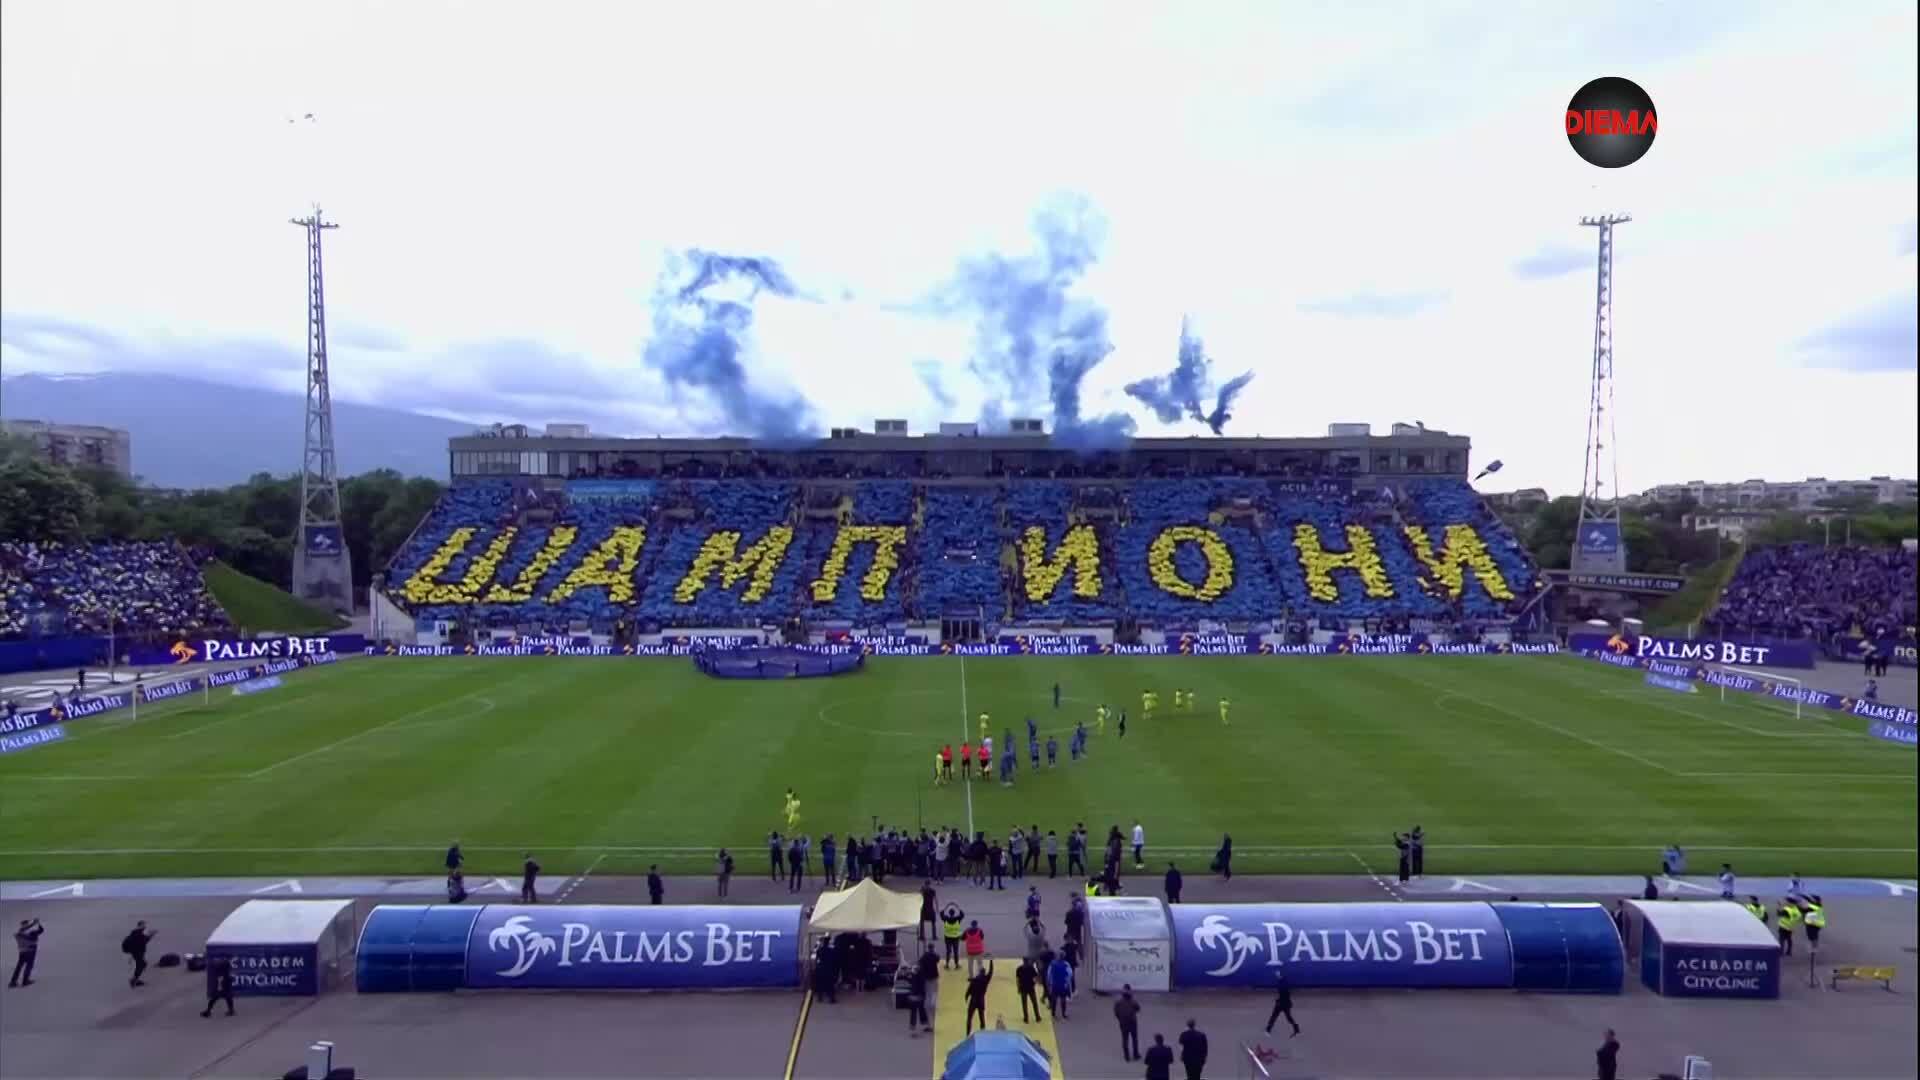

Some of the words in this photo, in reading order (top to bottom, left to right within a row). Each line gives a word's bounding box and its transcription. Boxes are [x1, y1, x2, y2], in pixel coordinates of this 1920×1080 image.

[522, 635, 554, 646] PALMS
[556, 636, 573, 646] BET
[854, 635, 886, 646] PALMS
[1028, 635, 1061, 645] PALMS
[1064, 635, 1081, 644] ET
[1227, 634, 1245, 644] BET
[1360, 634, 1392, 644] PAMS
[1394, 634, 1412, 644] BET
[204, 639, 282, 661] PALMS
[287, 636, 330, 656] BET
[399, 645, 433, 656] PALMS
[434, 645, 454, 656] BET
[478, 644, 511, 656] PALMS
[514, 644, 533, 656] BET
[557, 644, 590, 656] PALMS
[593, 644, 612, 656] BET
[672, 644, 691, 656] BET
[831, 644, 850, 655] BET
[875, 644, 909, 655] PALMS
[911, 644, 929, 655] BET
[955, 644, 988, 655] PALMS
[990, 644, 1010, 655] BET
[1034, 643, 1068, 654] PALMS
[1070, 643, 1089, 654] BET
[1114, 643, 1148, 654] PALMS
[1150, 643, 1169, 654] BET
[1193, 643, 1227, 654] PALMS
[1229, 643, 1248, 654] BET
[1273, 643, 1307, 654] PALMS
[1309, 643, 1328, 654] BET
[1352, 643, 1386, 654] PALMS
[1388, 643, 1407, 654] BET
[1432, 643, 1466, 654] PALMS
[1468, 643, 1486, 654] BET
[1512, 642, 1546, 654] PALMS
[1636, 635, 1715, 661] PALMS
[1721, 641, 1769, 664] BET
[1649, 660, 1674, 675] PALMS
[208, 671, 236, 687] PALMS
[1706, 670, 1735, 686] PALMS
[1735, 677, 1754, 689] BET
[144, 683, 175, 701] PALMS
[176, 681, 192, 694] BET
[1774, 682, 1806, 700] PALMS
[1807, 690, 1831, 704] BET
[65, 700, 104, 719] PALMS
[102, 695, 123, 709] BET
[1854, 699, 1895, 720] PALMS
[13, 713, 38, 730] BET
[0, 734, 38, 752] PALMS
[39, 727, 62, 742] BET
[557, 922, 694, 967] PALMS
[702, 923, 781, 966] BET
[1262, 921, 1403, 966] PALMS
[1405, 920, 1487, 965] BET
[231, 956, 305, 969] CIBADEM
[1676, 958, 1768, 971] ACIBADEM
